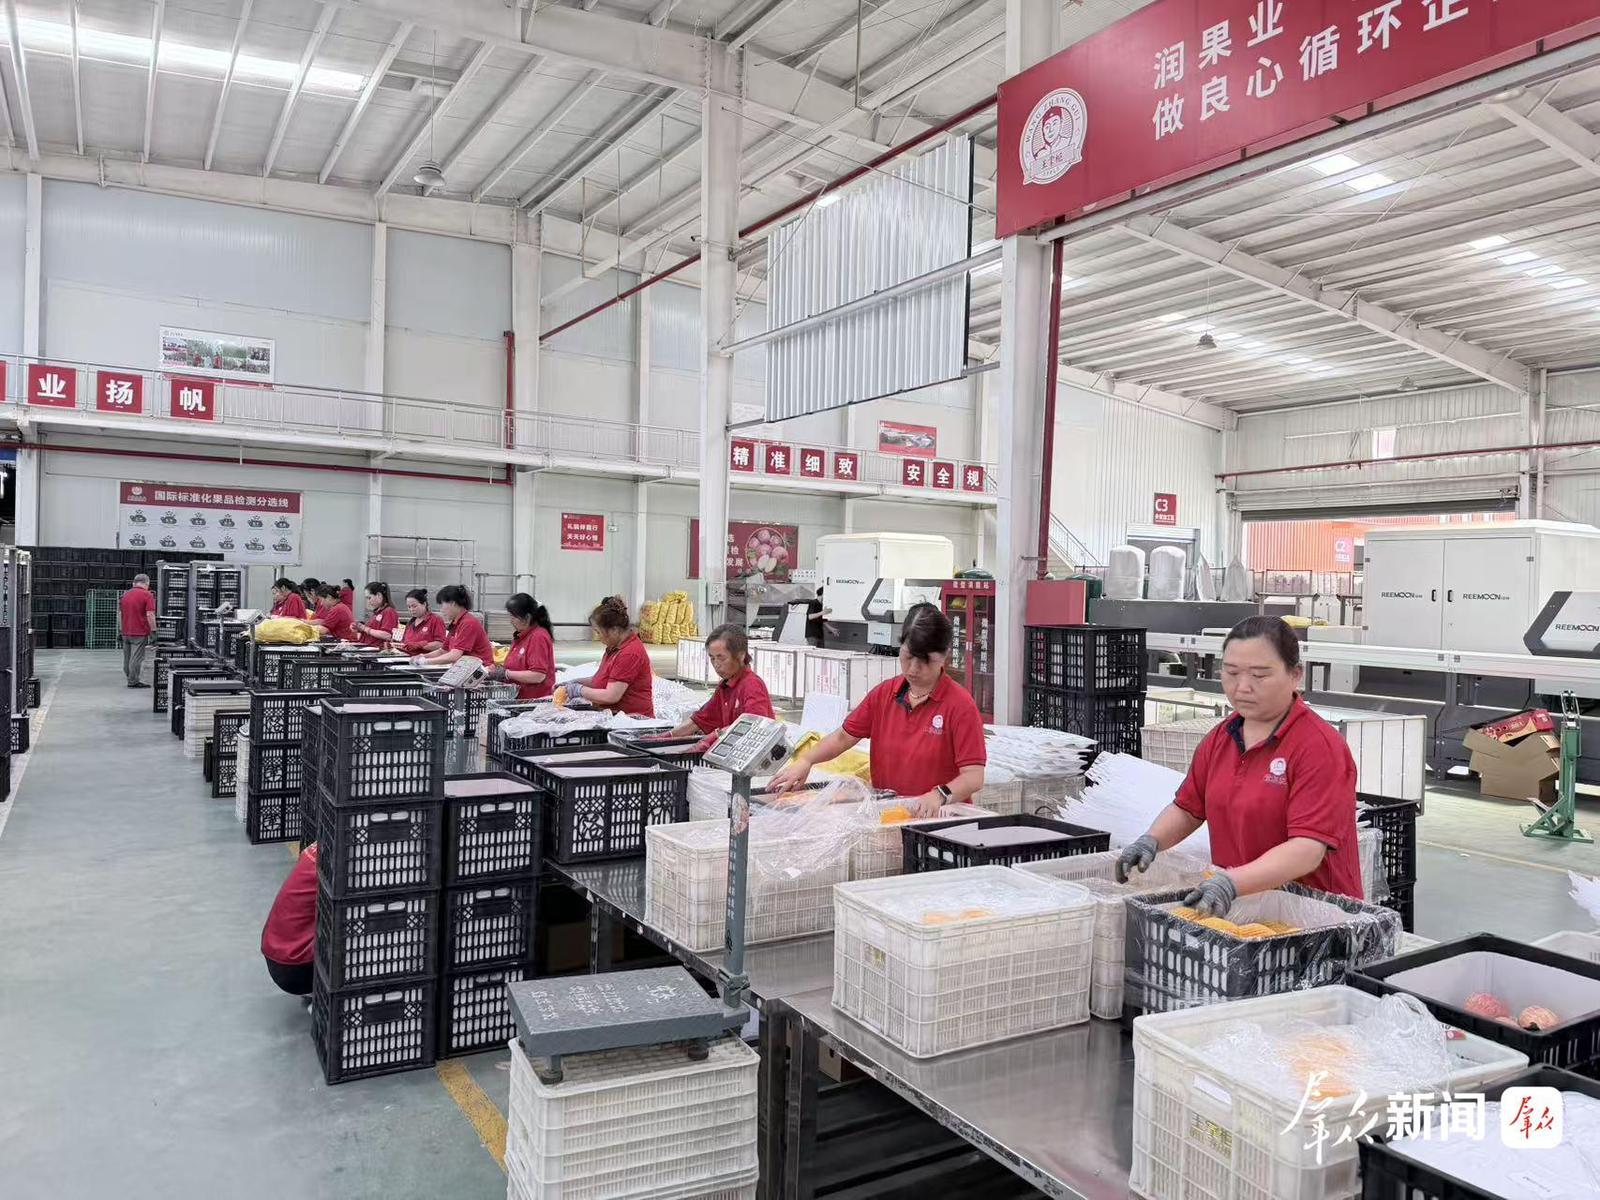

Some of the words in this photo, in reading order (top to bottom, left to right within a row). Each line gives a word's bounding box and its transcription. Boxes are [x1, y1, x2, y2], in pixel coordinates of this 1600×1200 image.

[1026, 112, 1042, 143] WANG
[732, 446, 854, 475] 精准细致
[907, 463, 980, 487] 安全规
[154, 490, 290, 508] 国际标准化果品检测分选线
[1155, 498, 1168, 512] C3
[1381, 591, 1415, 599] REEMOON
[1462, 593, 1501, 601] REEMOON
[1554, 623, 1600, 632] REEMOON
